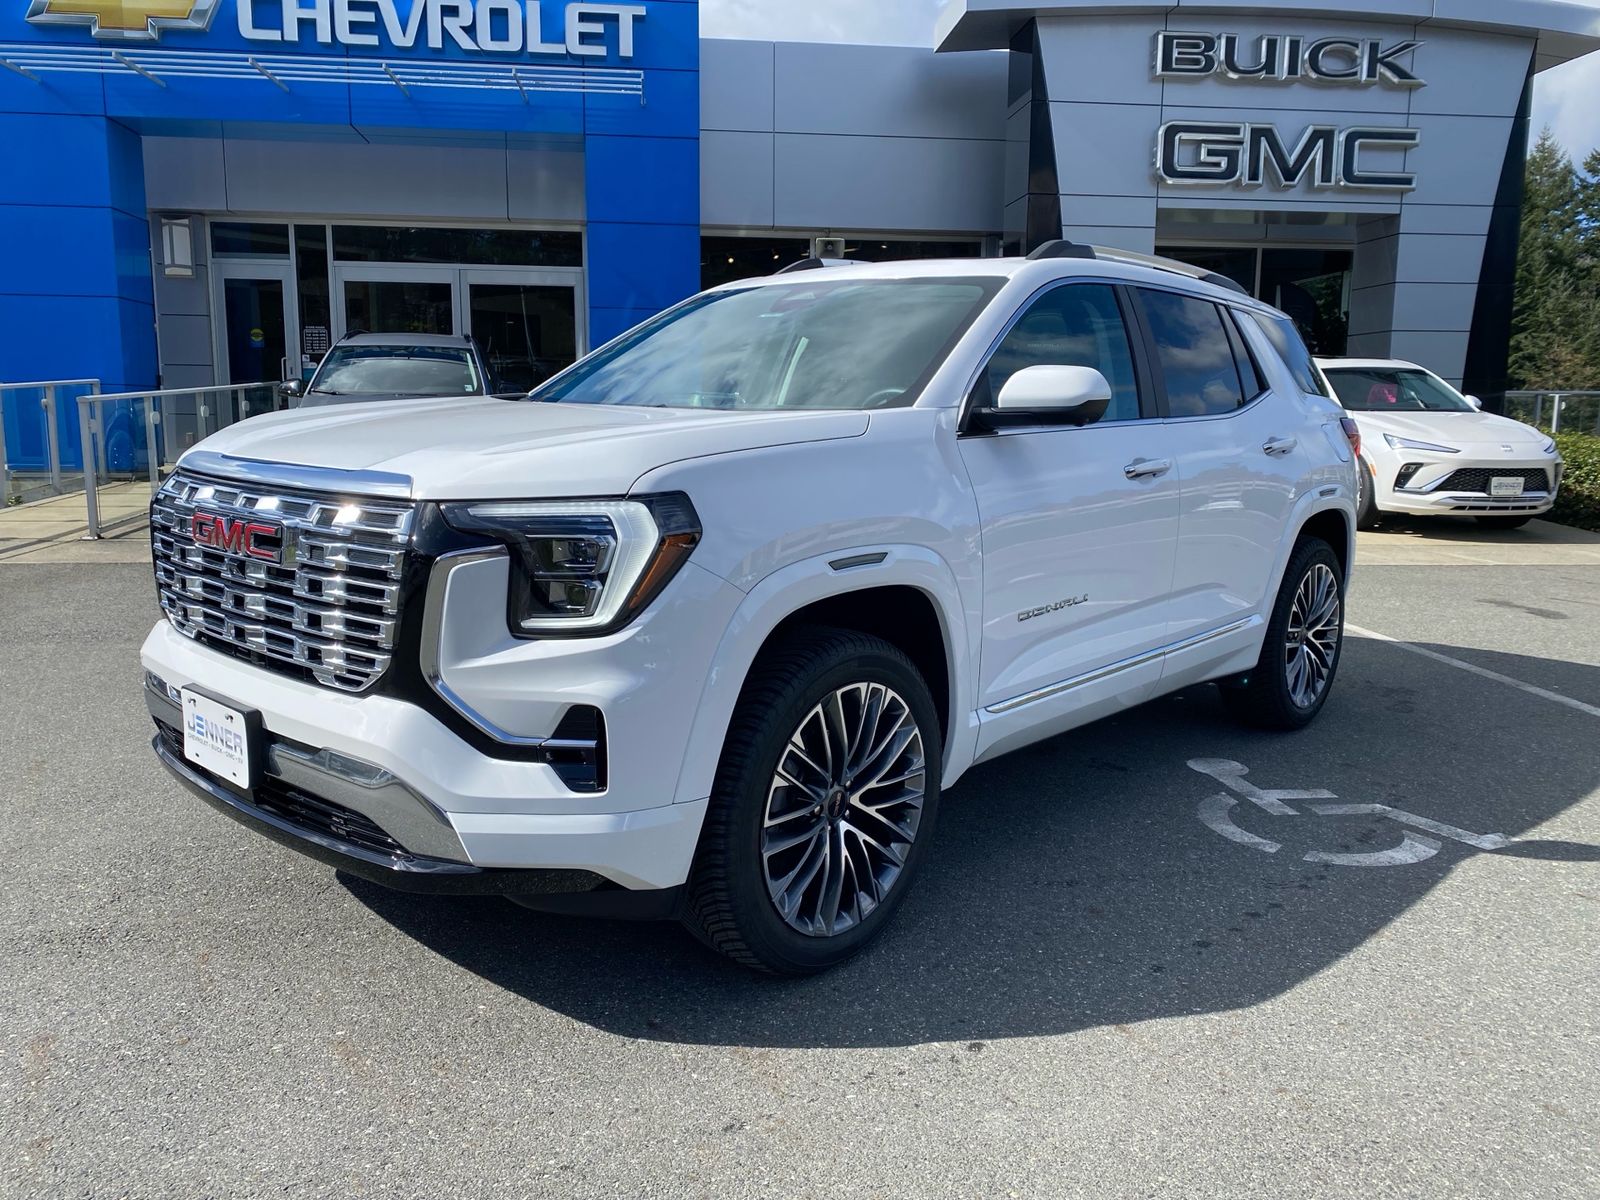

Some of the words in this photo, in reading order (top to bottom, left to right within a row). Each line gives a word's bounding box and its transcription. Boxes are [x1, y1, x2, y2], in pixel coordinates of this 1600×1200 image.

[237, 0, 647, 57] CHEVROLET
[1153, 30, 1427, 87] BUICK
[1155, 121, 1420, 190] GMC
[192, 511, 282, 560] GMC
[187, 713, 243, 756] JENNER
